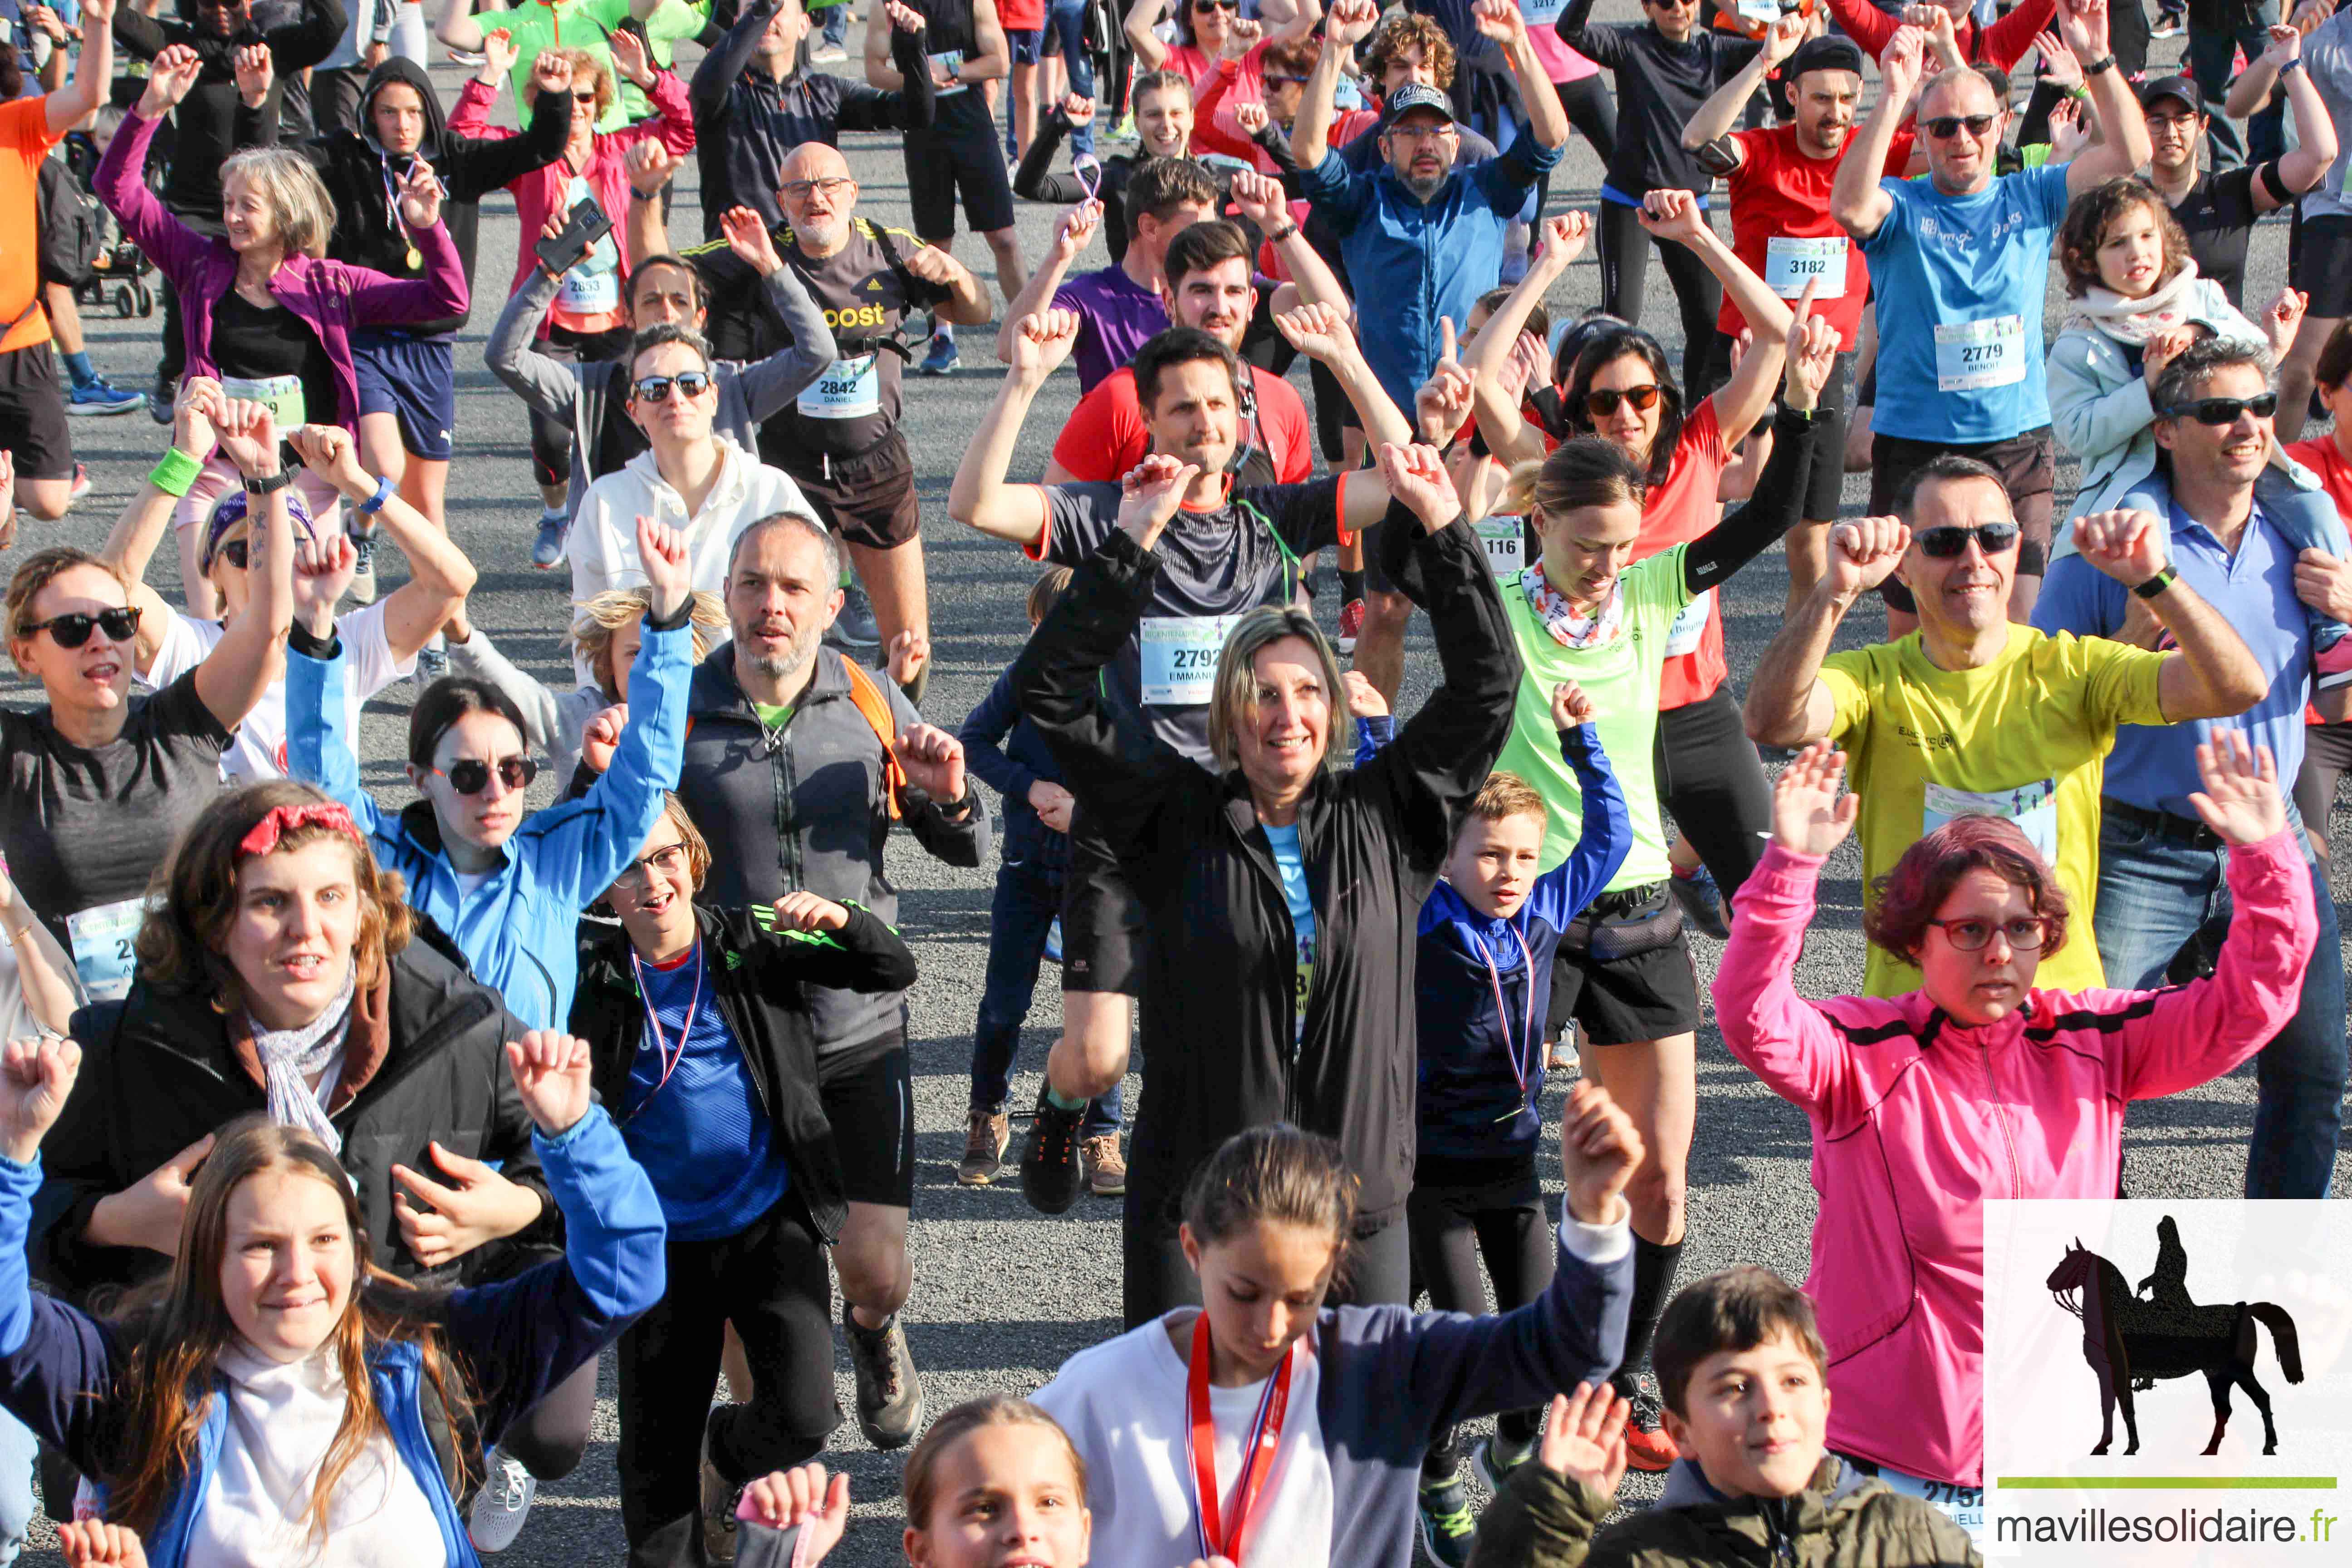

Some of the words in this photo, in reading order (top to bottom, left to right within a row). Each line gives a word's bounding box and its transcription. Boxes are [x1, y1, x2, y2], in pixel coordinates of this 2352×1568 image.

[1790, 260, 1826, 274] 3182
[570, 280, 600, 292] 2853
[1962, 343, 2003, 363] 2779
[1968, 362, 1999, 372] BENOIT
[820, 380, 857, 394] 2842
[1487, 539, 1516, 554] 116
